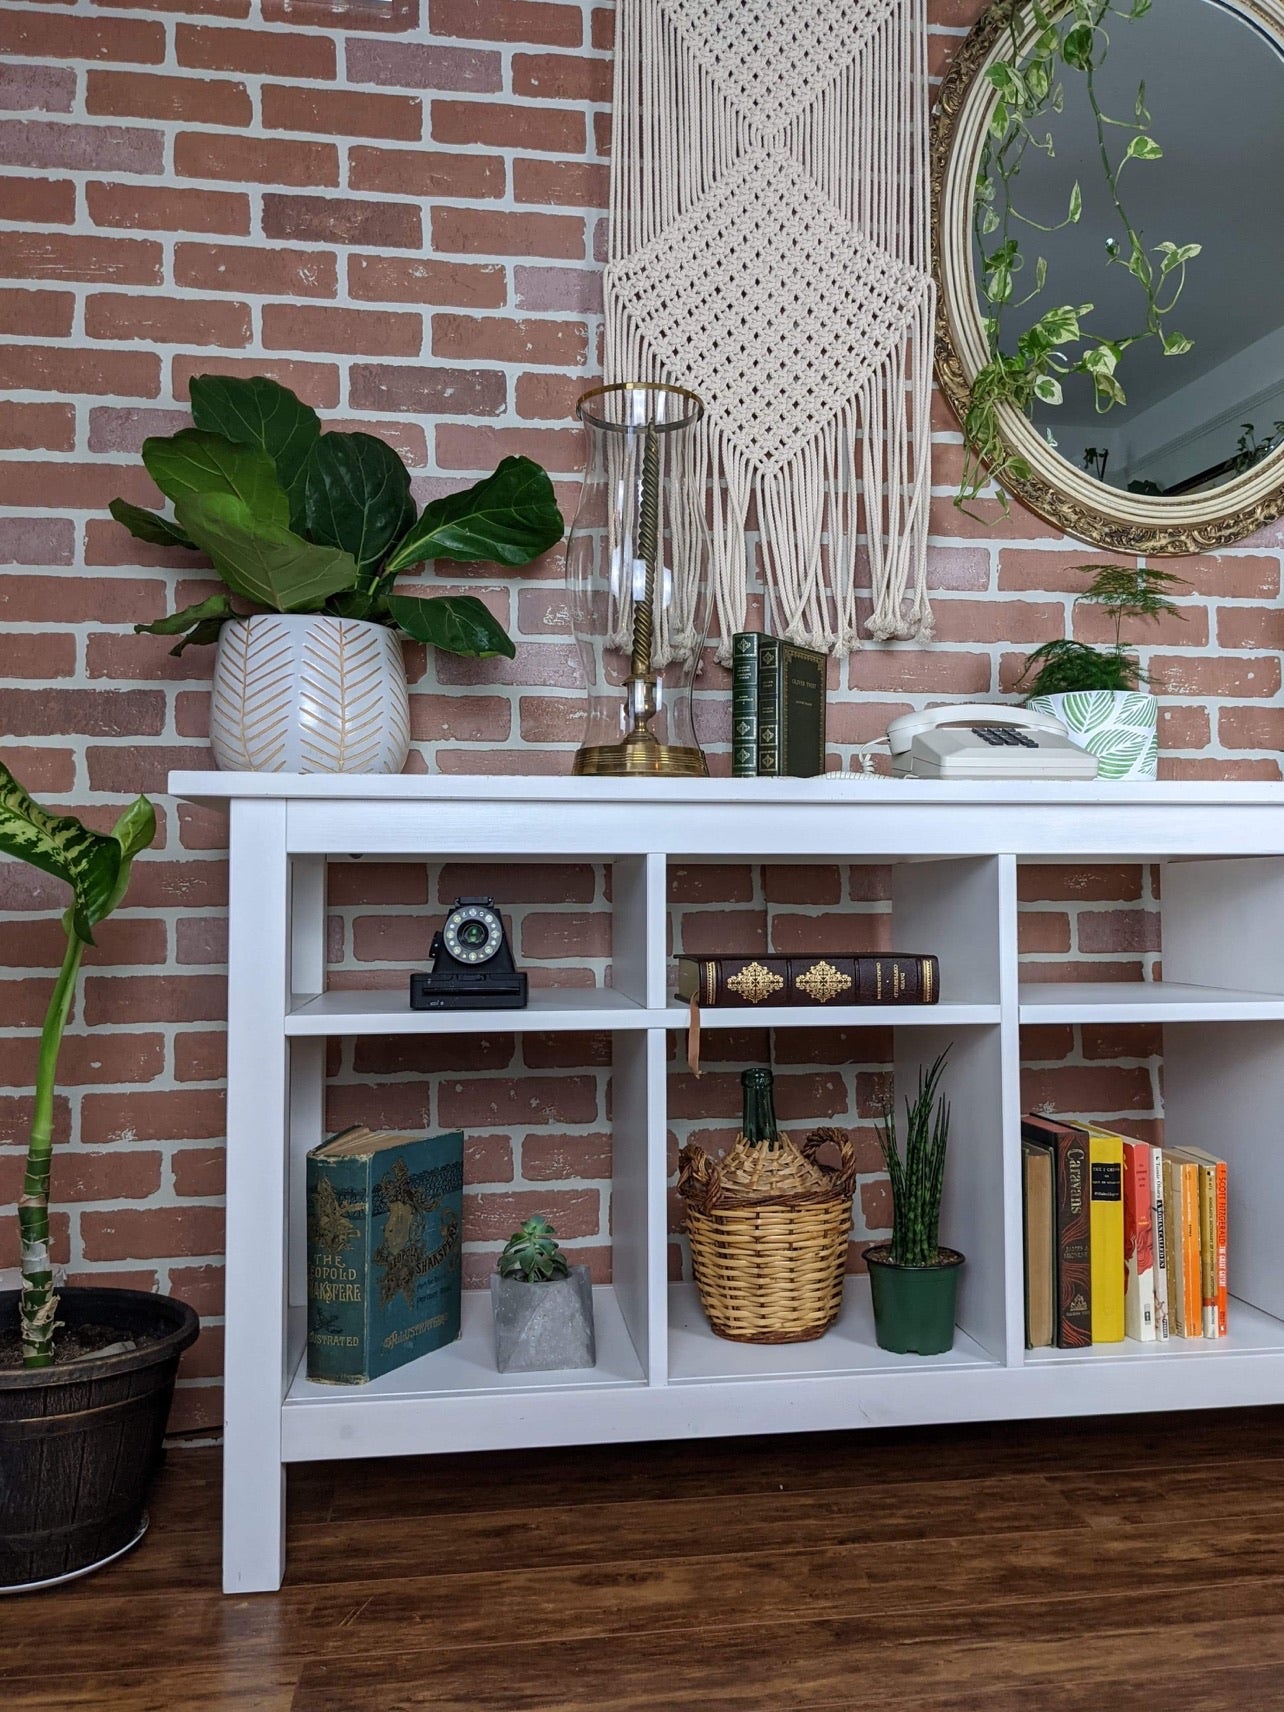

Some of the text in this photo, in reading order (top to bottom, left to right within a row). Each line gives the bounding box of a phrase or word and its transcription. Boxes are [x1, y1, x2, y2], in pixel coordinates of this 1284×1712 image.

[1066, 1148, 1085, 1215] Caravans
[1219, 1177, 1227, 1200] SCOTT
[1218, 1202, 1226, 1244] FITZGERALD
[314, 1253, 346, 1268] THE
[309, 1266, 357, 1280] EOPOLD
